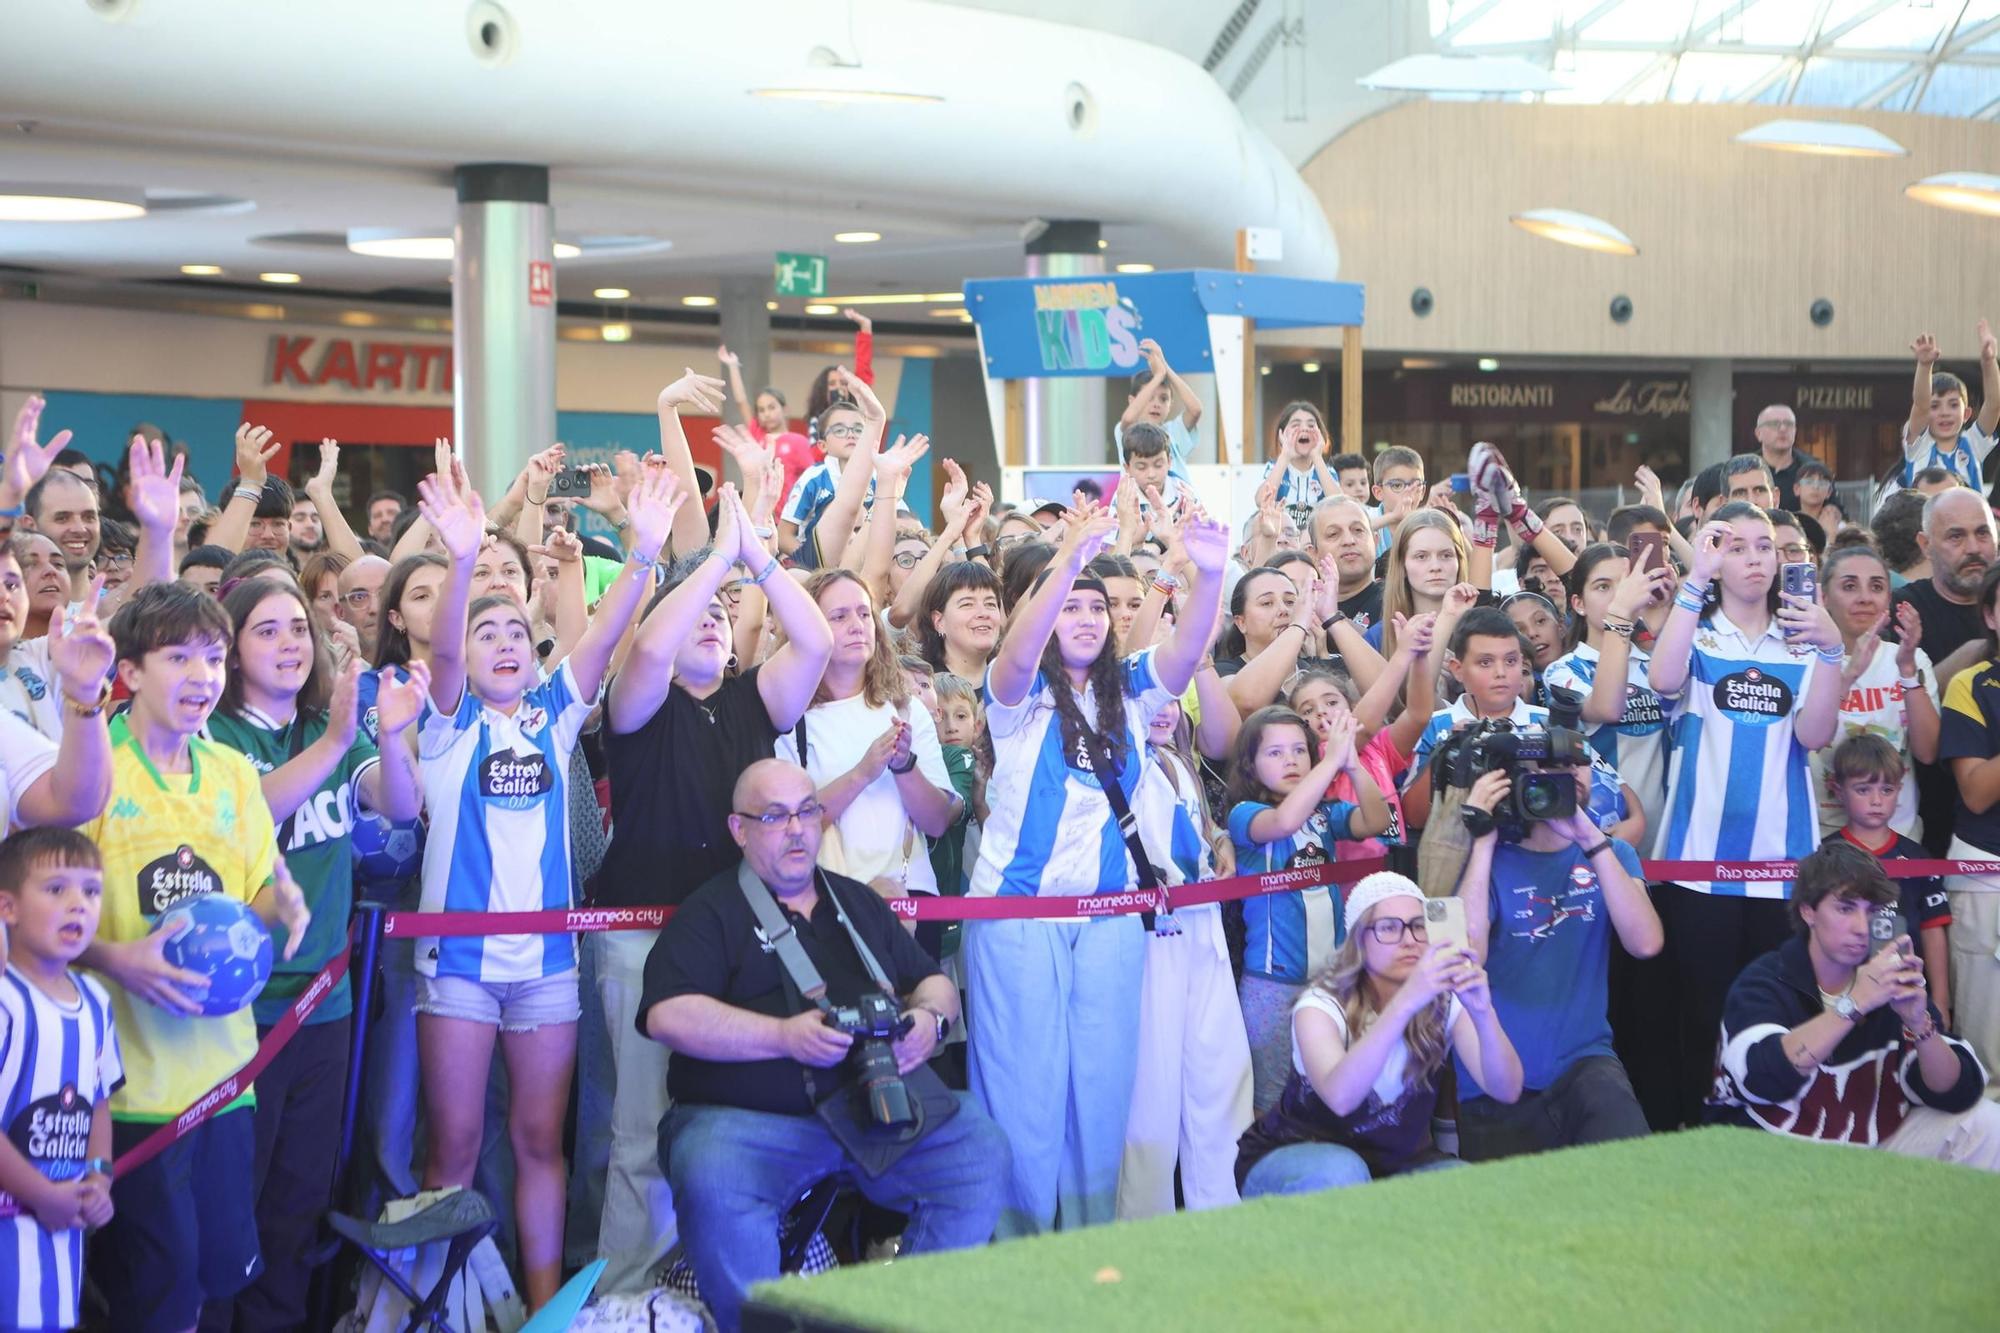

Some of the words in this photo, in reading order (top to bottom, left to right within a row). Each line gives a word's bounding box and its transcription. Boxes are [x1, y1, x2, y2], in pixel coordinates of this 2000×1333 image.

[1035, 303, 1139, 370] KIDS
[1450, 384, 1553, 408] RISTORANTI
[1796, 385, 1873, 409] PIZZERIE
[1725, 679, 1782, 698] Estrella
[1625, 694, 1660, 709] trella
[1727, 693, 1778, 713] Galicia
[151, 866, 214, 893] Estrella
[1261, 870, 1303, 886] marineda
[1303, 867, 1321, 882] city
[1715, 864, 1743, 879] city
[890, 899, 917, 916] city
[1077, 894, 1133, 910] marineda
[1134, 892, 1156, 907] city
[566, 909, 634, 925] marineda
[636, 909, 664, 926] city
[177, 1090, 219, 1131] marineda
[219, 1076, 238, 1099] city
[28, 1107, 91, 1135] Estrella
[28, 1132, 87, 1158] Galicia
